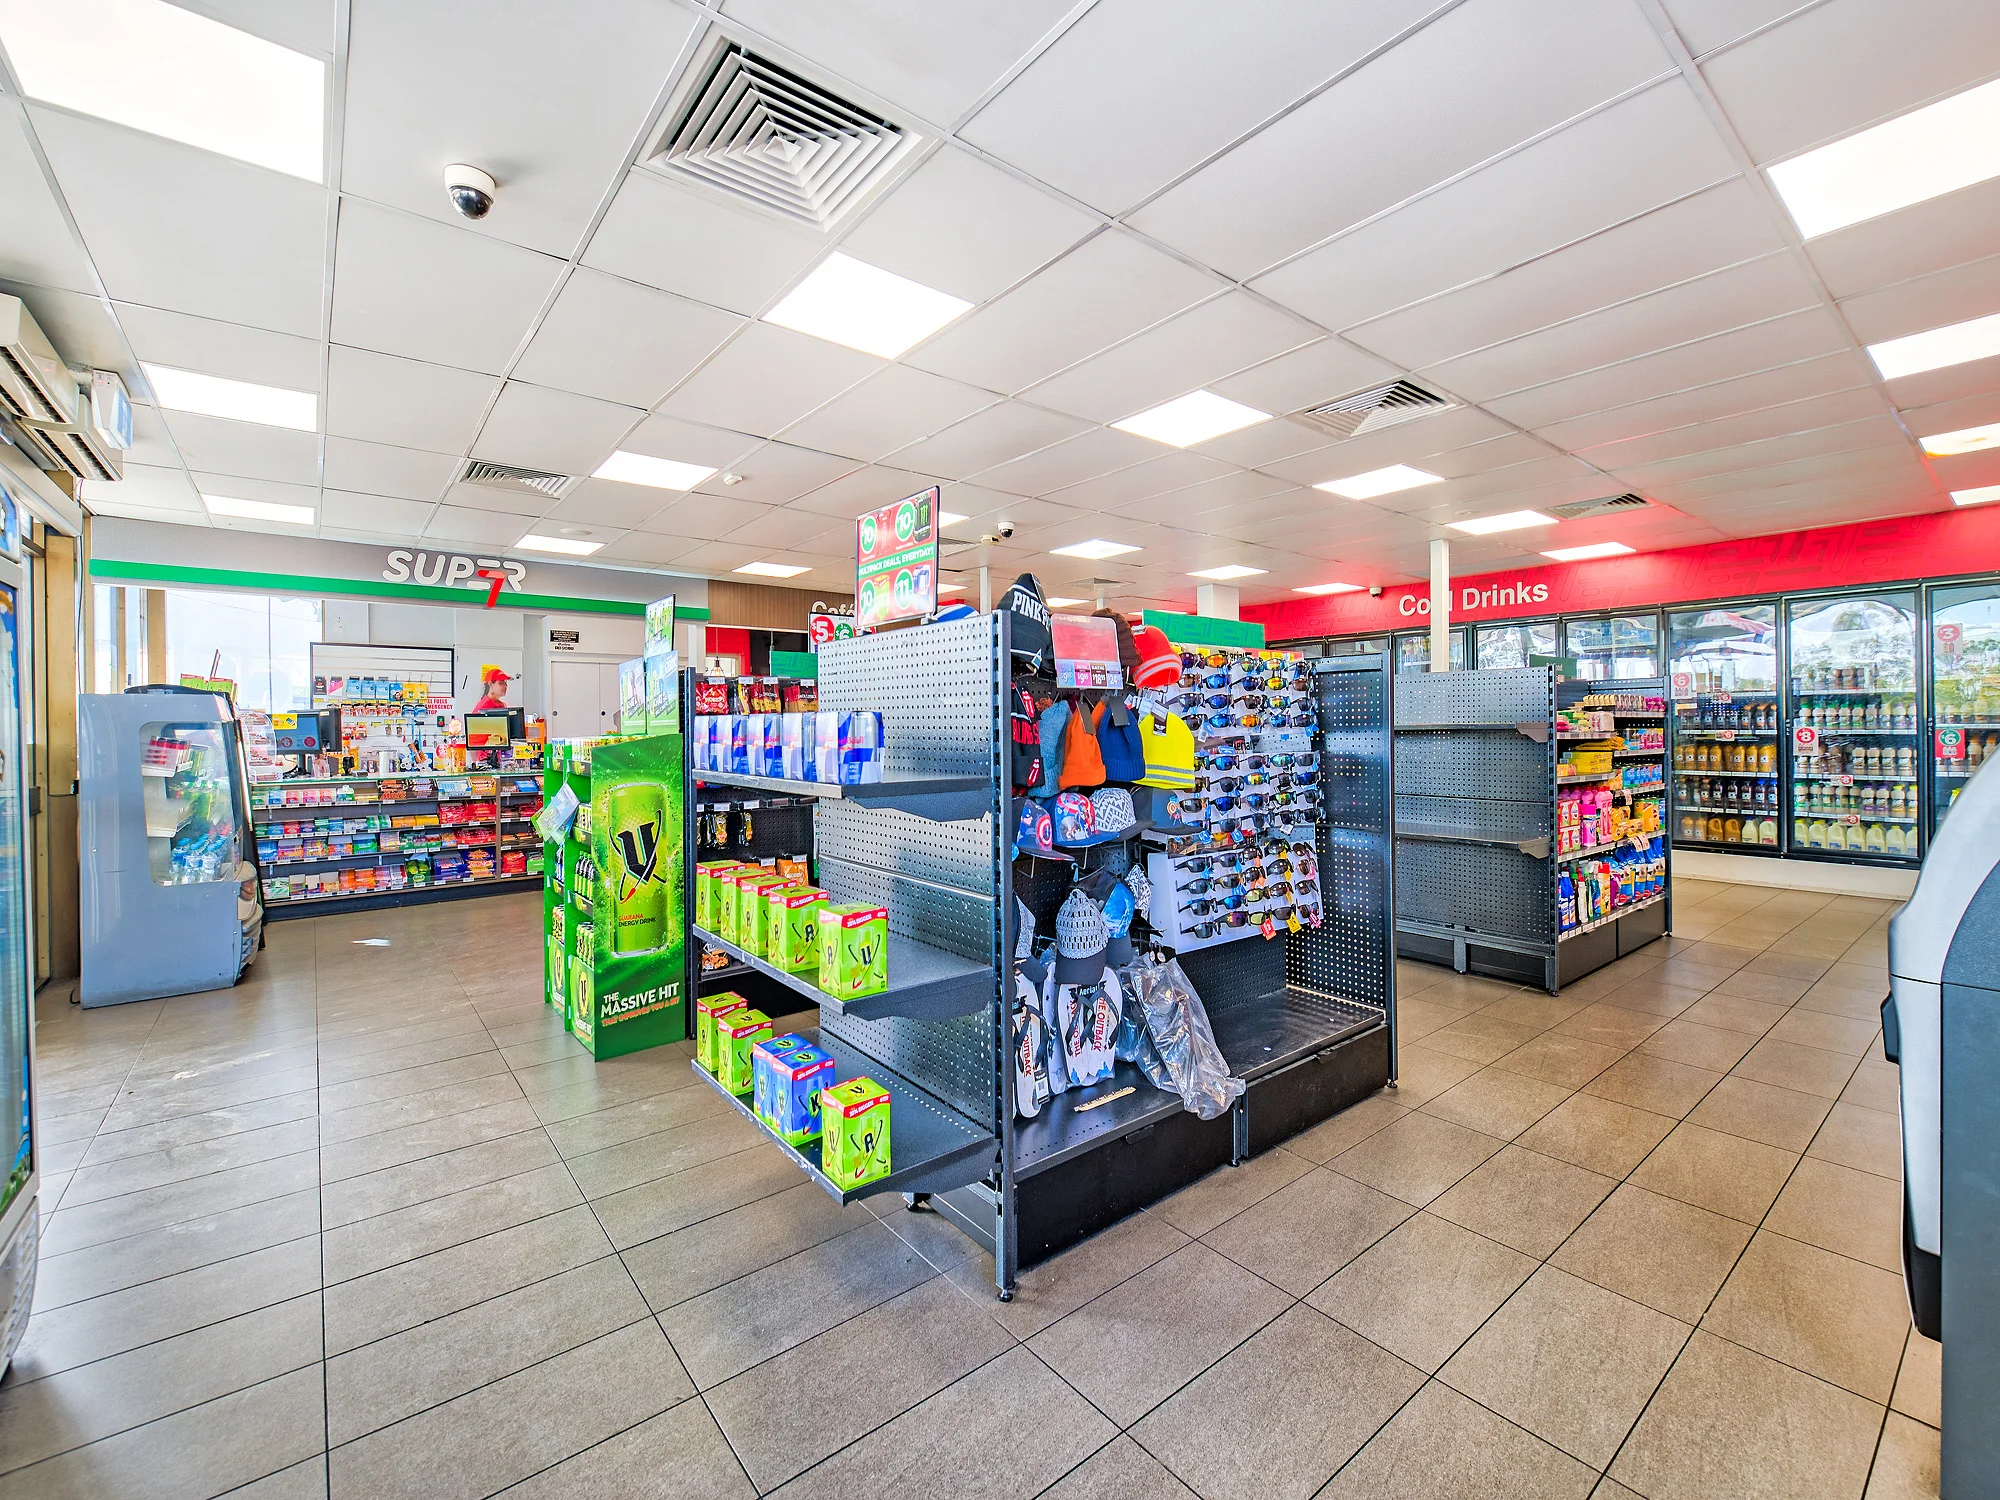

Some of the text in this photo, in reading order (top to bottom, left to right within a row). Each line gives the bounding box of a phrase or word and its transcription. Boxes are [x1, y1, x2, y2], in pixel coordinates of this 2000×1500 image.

[383, 550, 526, 592] SUPER
[1011, 591, 1042, 623] PINK
[1399, 581, 1549, 616] Co Drinks
[618, 913, 644, 921] GUARANA
[618, 916, 657, 928] ENERGY DRINK
[600, 982, 680, 1018] MASSIVE HIT
[603, 991, 619, 1004] THE
[1080, 985, 1098, 996] Aerial
[1094, 996, 1107, 1052] HE OUTBACK
